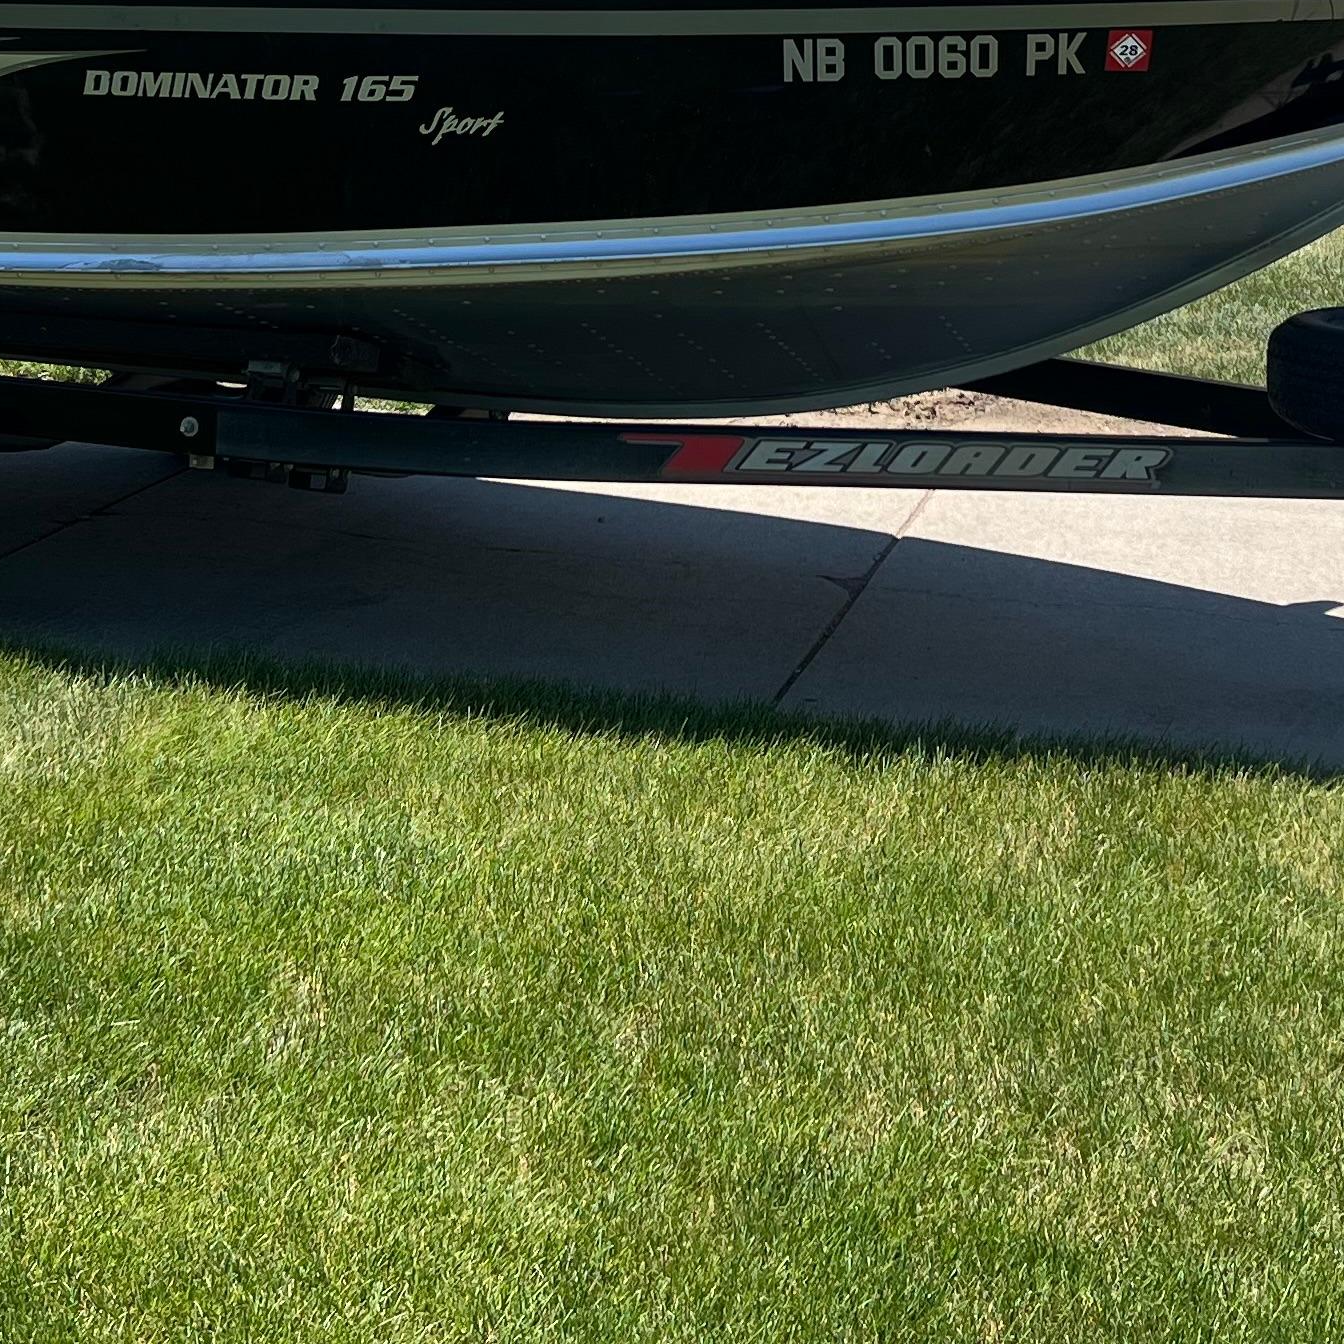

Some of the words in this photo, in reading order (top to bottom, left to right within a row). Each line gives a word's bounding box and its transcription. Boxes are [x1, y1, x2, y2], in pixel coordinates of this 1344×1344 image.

[782, 38, 845, 83] NB
[874, 34, 999, 80] 0060
[1025, 31, 1088, 77] PK
[1118, 44, 1139, 56] 28
[83, 69, 320, 102] DOMINATOR
[340, 75, 420, 102] 165
[419, 106, 505, 146] Sport
[736, 438, 1170, 482] EZLOADER
